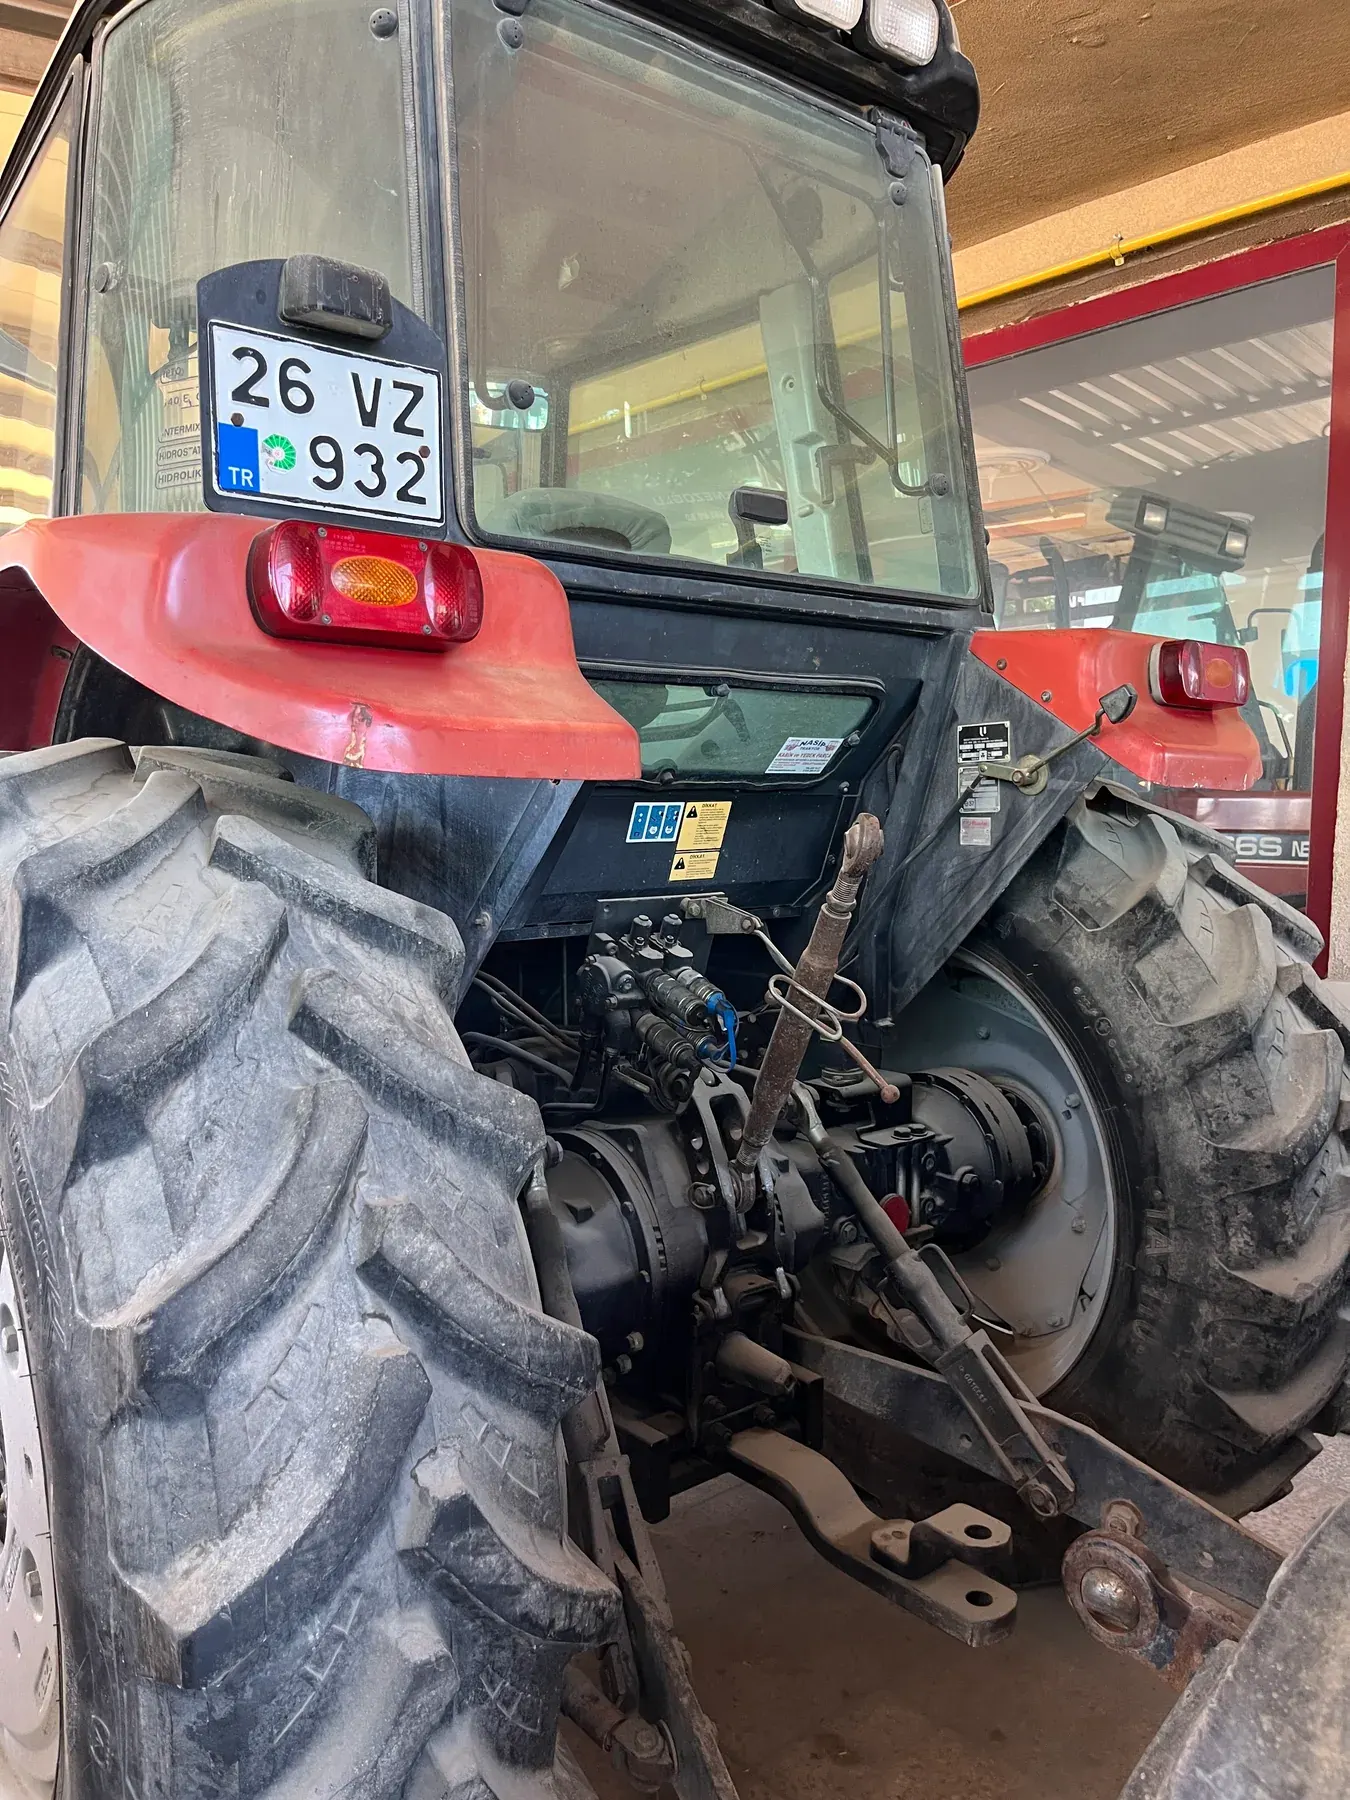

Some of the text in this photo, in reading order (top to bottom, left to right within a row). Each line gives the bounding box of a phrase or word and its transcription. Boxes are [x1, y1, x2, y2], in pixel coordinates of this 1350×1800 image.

[231, 346, 425, 438] 26 VZ
[228, 466, 254, 488] TR
[309, 435, 427, 505] 932
[1225, 836, 1283, 857] 6S
